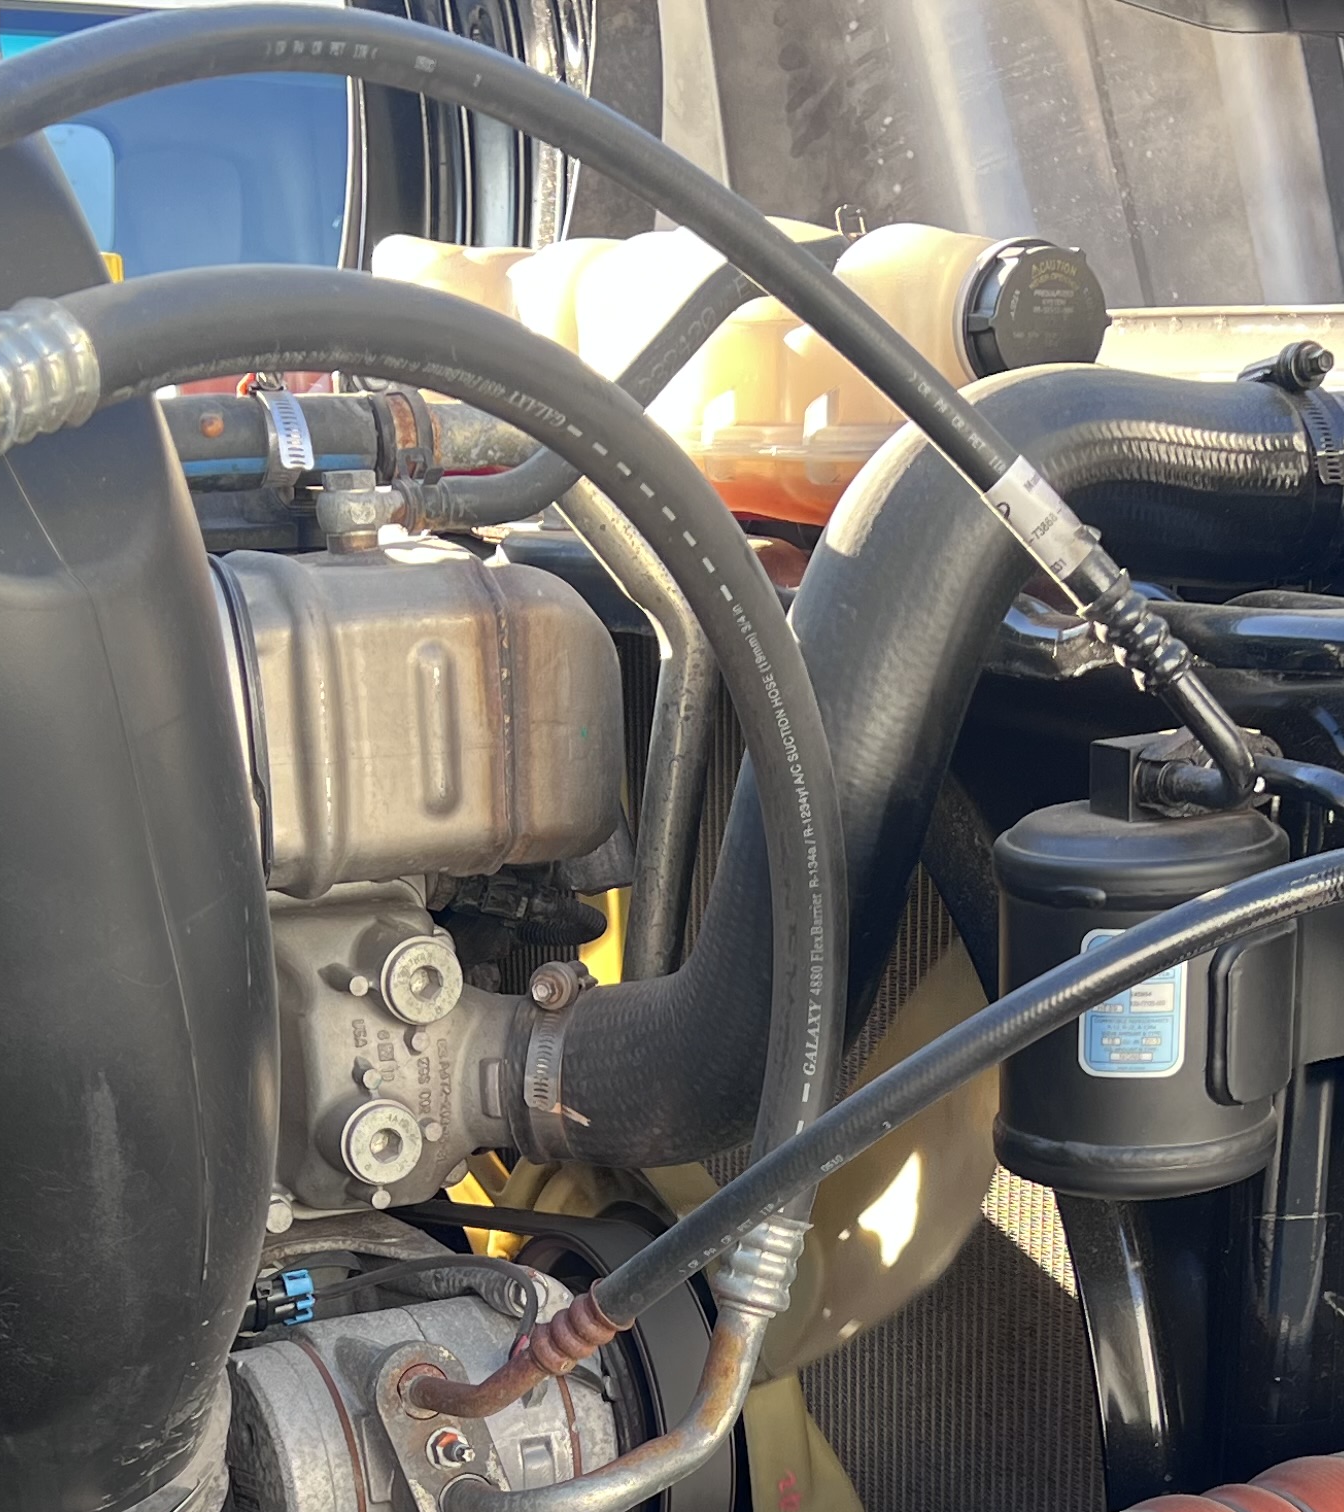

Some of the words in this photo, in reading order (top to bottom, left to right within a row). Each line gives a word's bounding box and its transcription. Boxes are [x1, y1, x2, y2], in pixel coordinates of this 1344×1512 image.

[1039, 259, 1077, 276] CAUTION
[917, 382, 931, 398] CR
[951, 415, 965, 431] CR
[968, 432, 986, 451] PET
[732, 603, 744, 616] in
[737, 614, 752, 634] 3/4
[745, 632, 772, 673] (19mm)
[762, 673, 782, 708] HOSE
[775, 709, 800, 763] SUCTION
[790, 763, 805, 785] A/C
[807, 846, 820, 889] R-134a
[808, 893, 824, 962] FlexBarrier
[809, 965, 823, 996] 4880
[803, 999, 821, 1076] GALAXY
